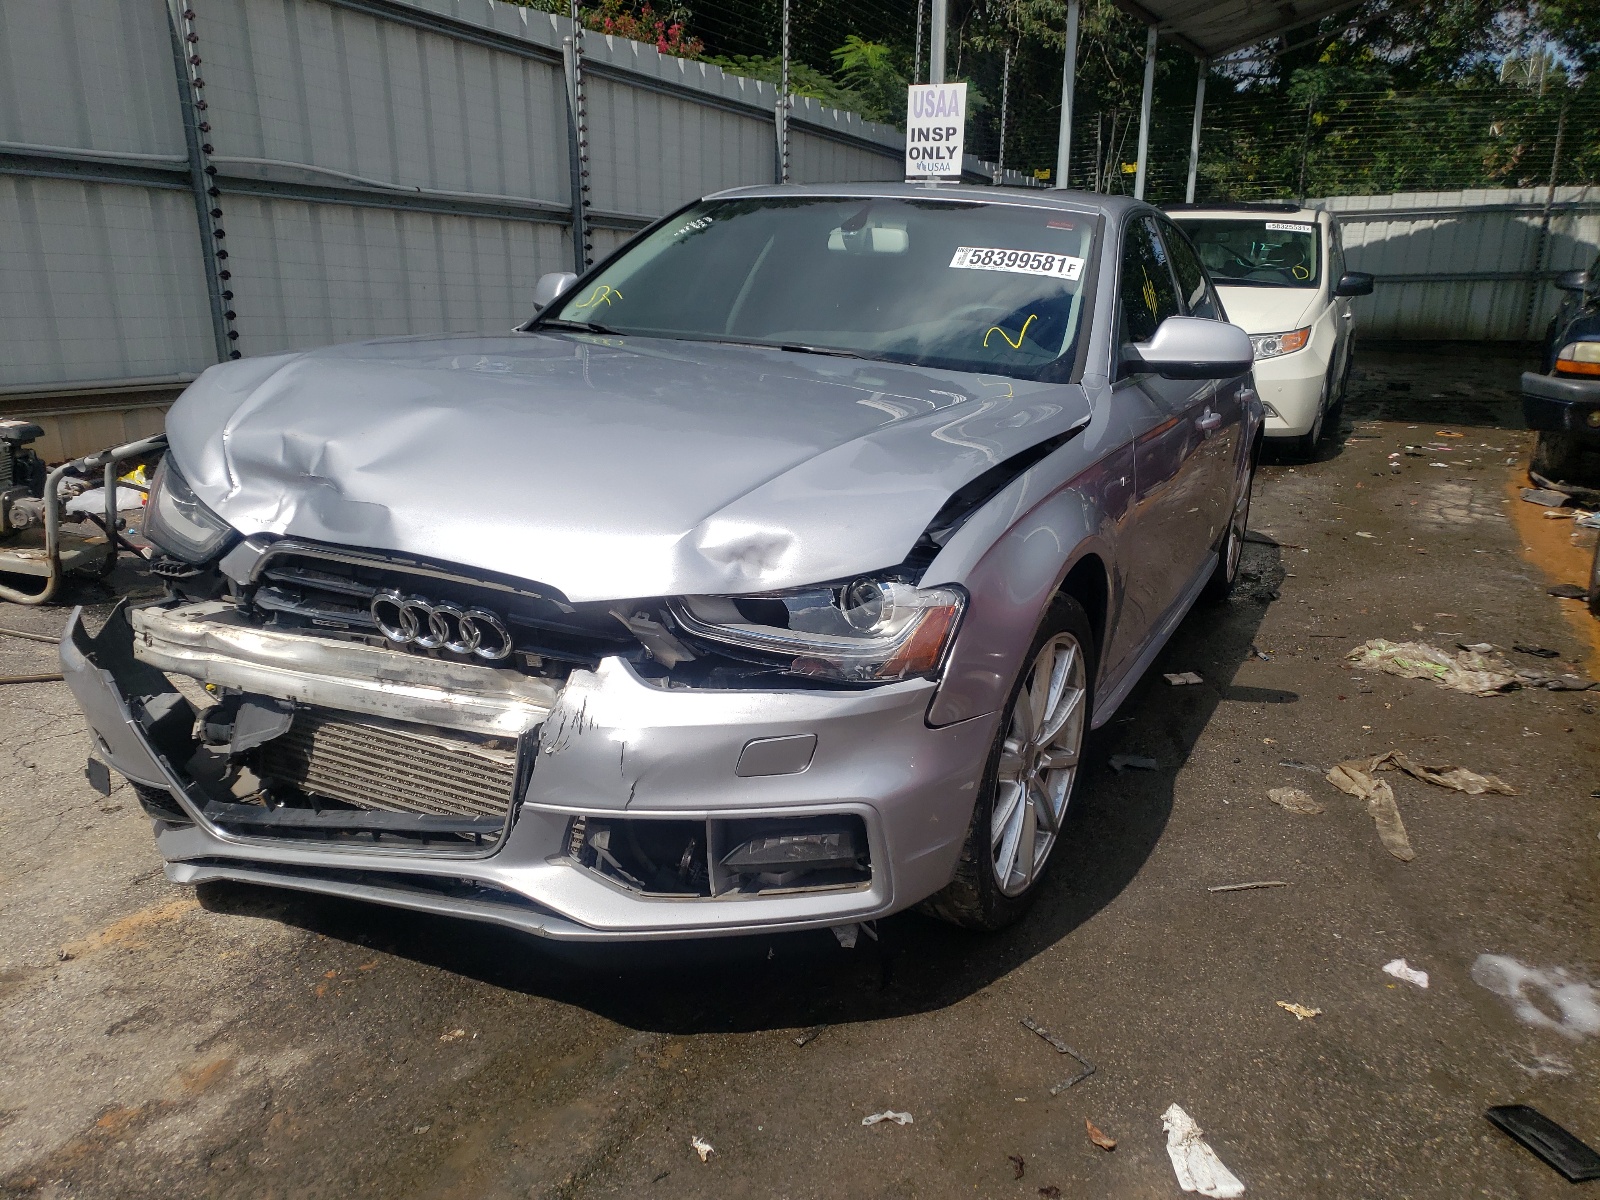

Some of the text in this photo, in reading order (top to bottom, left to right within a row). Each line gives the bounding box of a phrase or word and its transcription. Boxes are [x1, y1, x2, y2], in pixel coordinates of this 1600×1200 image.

[913, 89, 960, 118] USAA
[910, 126, 957, 142] INSP
[908, 145, 958, 160] ONLY
[927, 162, 950, 172] USAA
[969, 249, 1067, 273] 58399581
[1067, 263, 1077, 273] F
